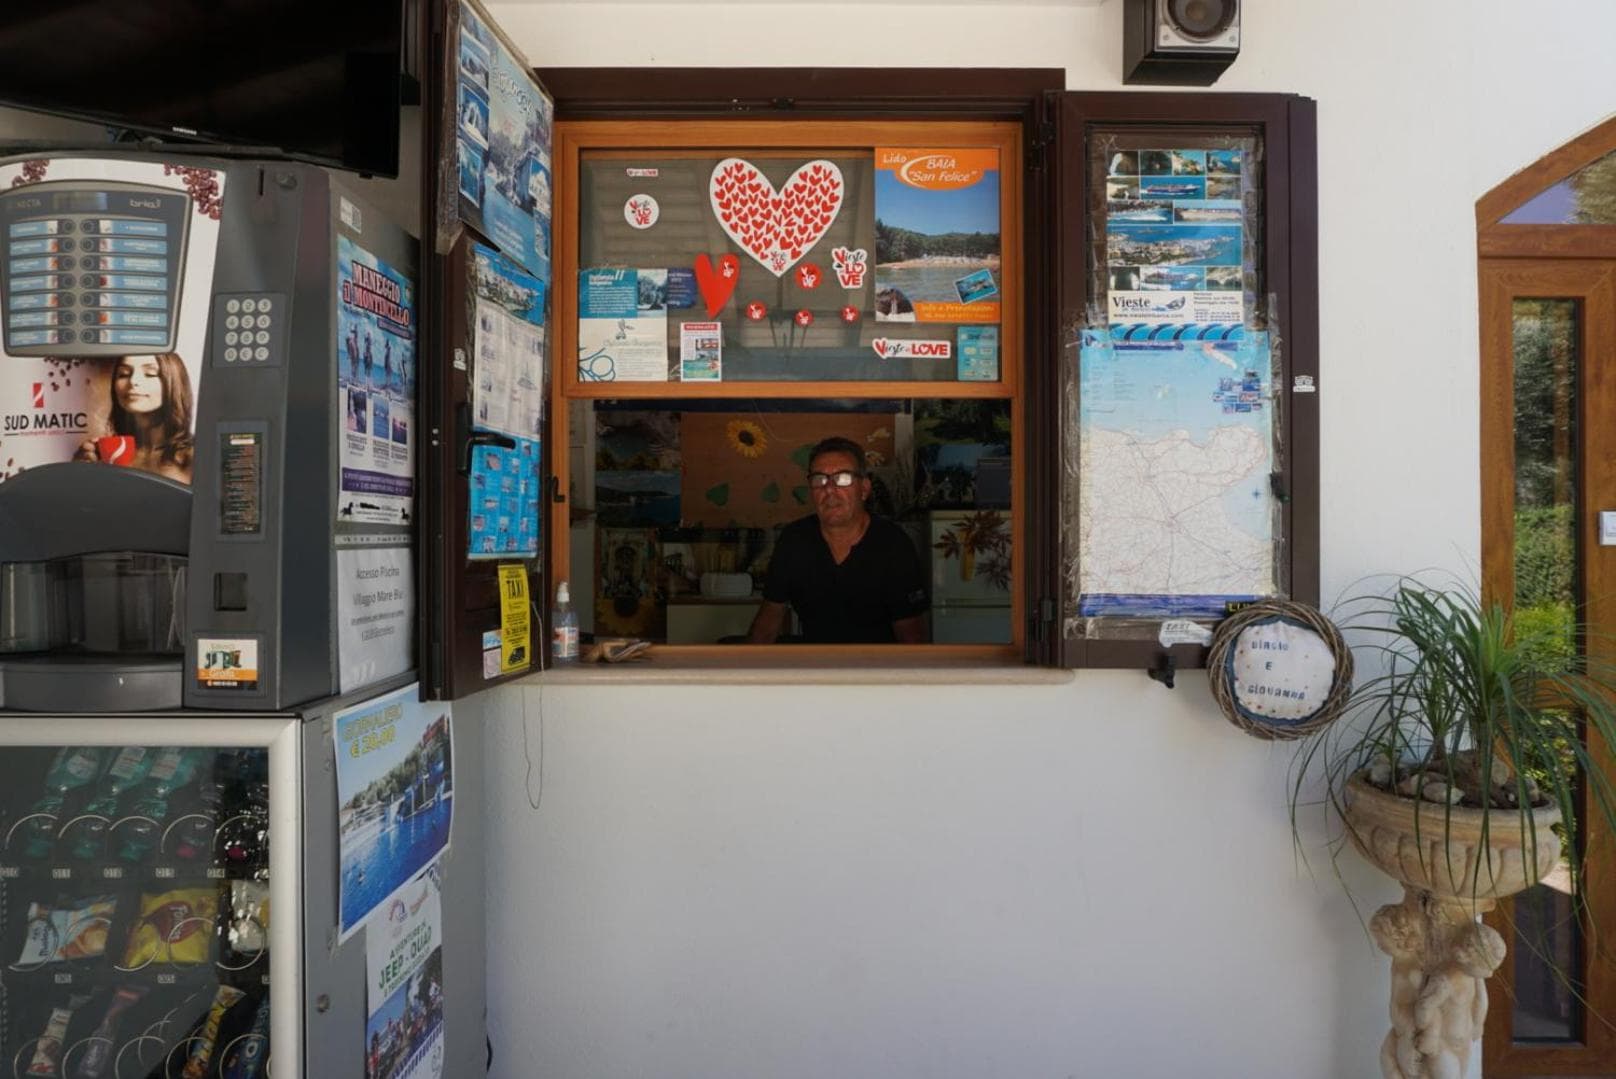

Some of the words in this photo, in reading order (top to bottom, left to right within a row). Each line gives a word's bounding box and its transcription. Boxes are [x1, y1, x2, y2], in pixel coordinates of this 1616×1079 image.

[883, 152, 907, 164] Lido
[926, 159, 956, 169] BAIA
[1112, 296, 1151, 309] Vieste
[911, 343, 948, 355] LOVE
[4, 415, 29, 431] SUD
[33, 413, 88, 429] MATIC
[506, 579, 525, 600] TAXI
[1265, 661, 1273, 671] E
[378, 953, 404, 990] JEEP
